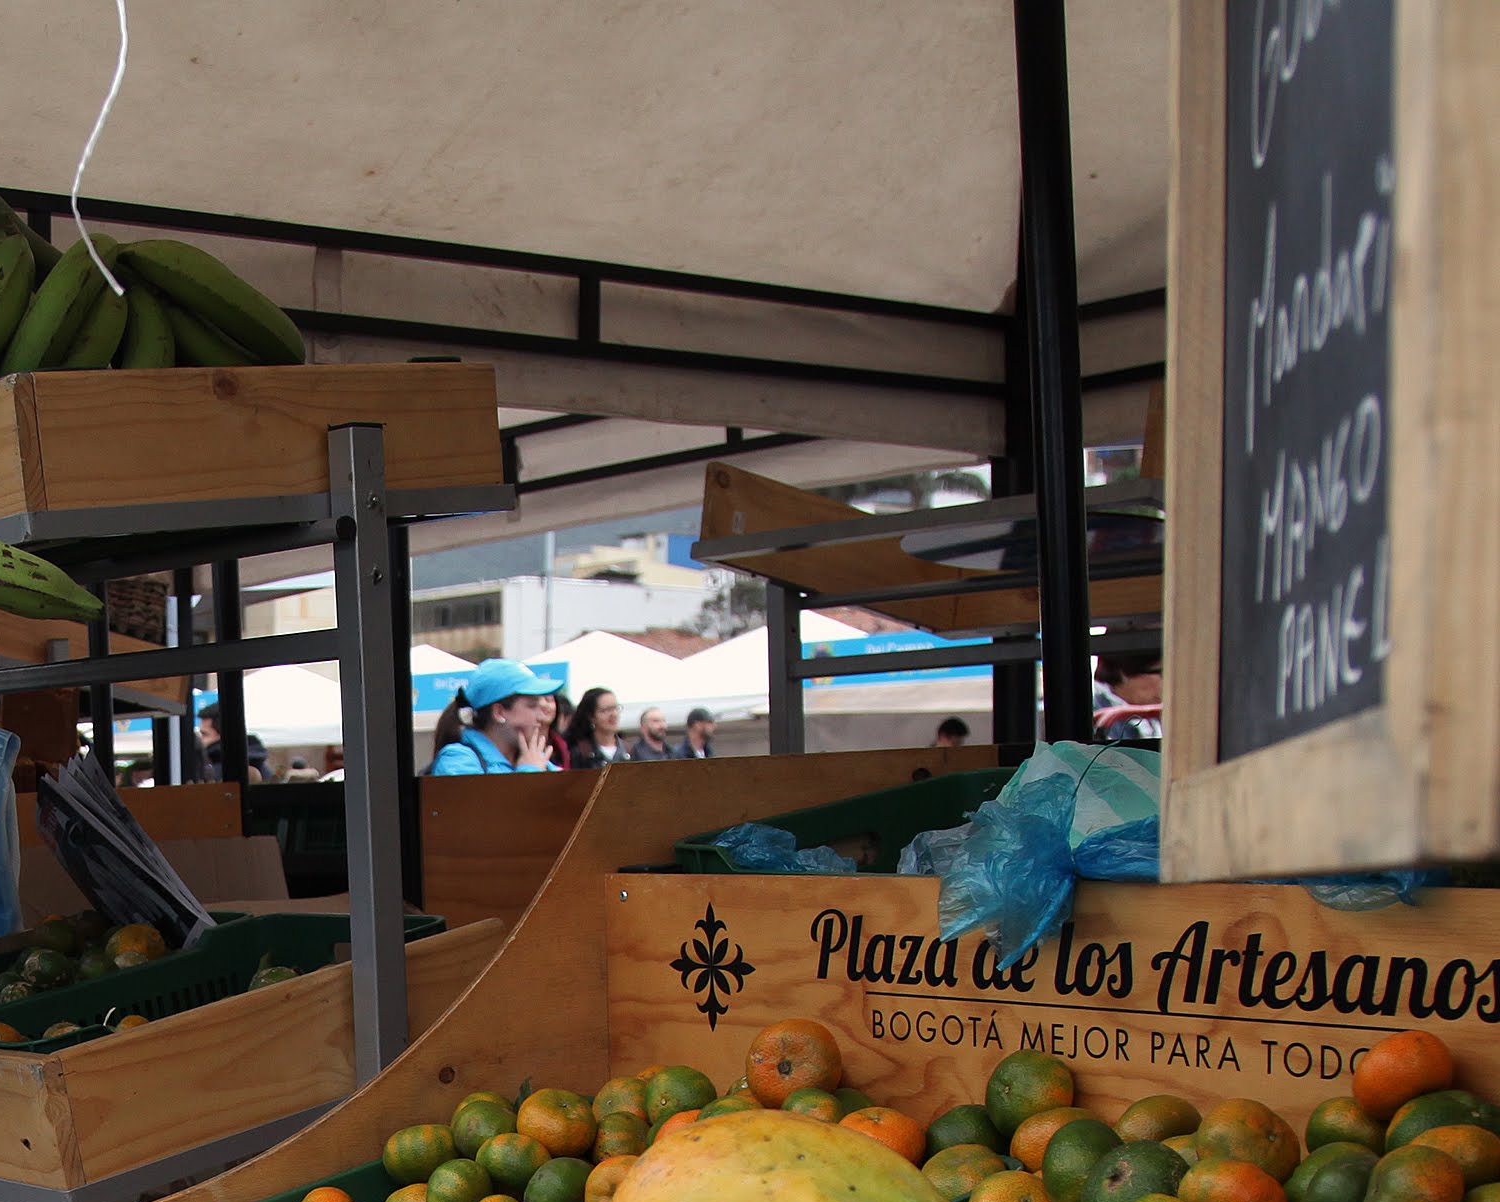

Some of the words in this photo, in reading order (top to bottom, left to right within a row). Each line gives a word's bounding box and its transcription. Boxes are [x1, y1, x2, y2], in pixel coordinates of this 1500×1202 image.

[810, 908, 958, 988] Plaza
[1053, 920, 1133, 999] los
[1150, 920, 1500, 1024] Artesanos
[871, 1008, 1003, 1050] BOGOTÁ
[1019, 1021, 1130, 1061] MEJOR
[1150, 1031, 1241, 1072] PARA
